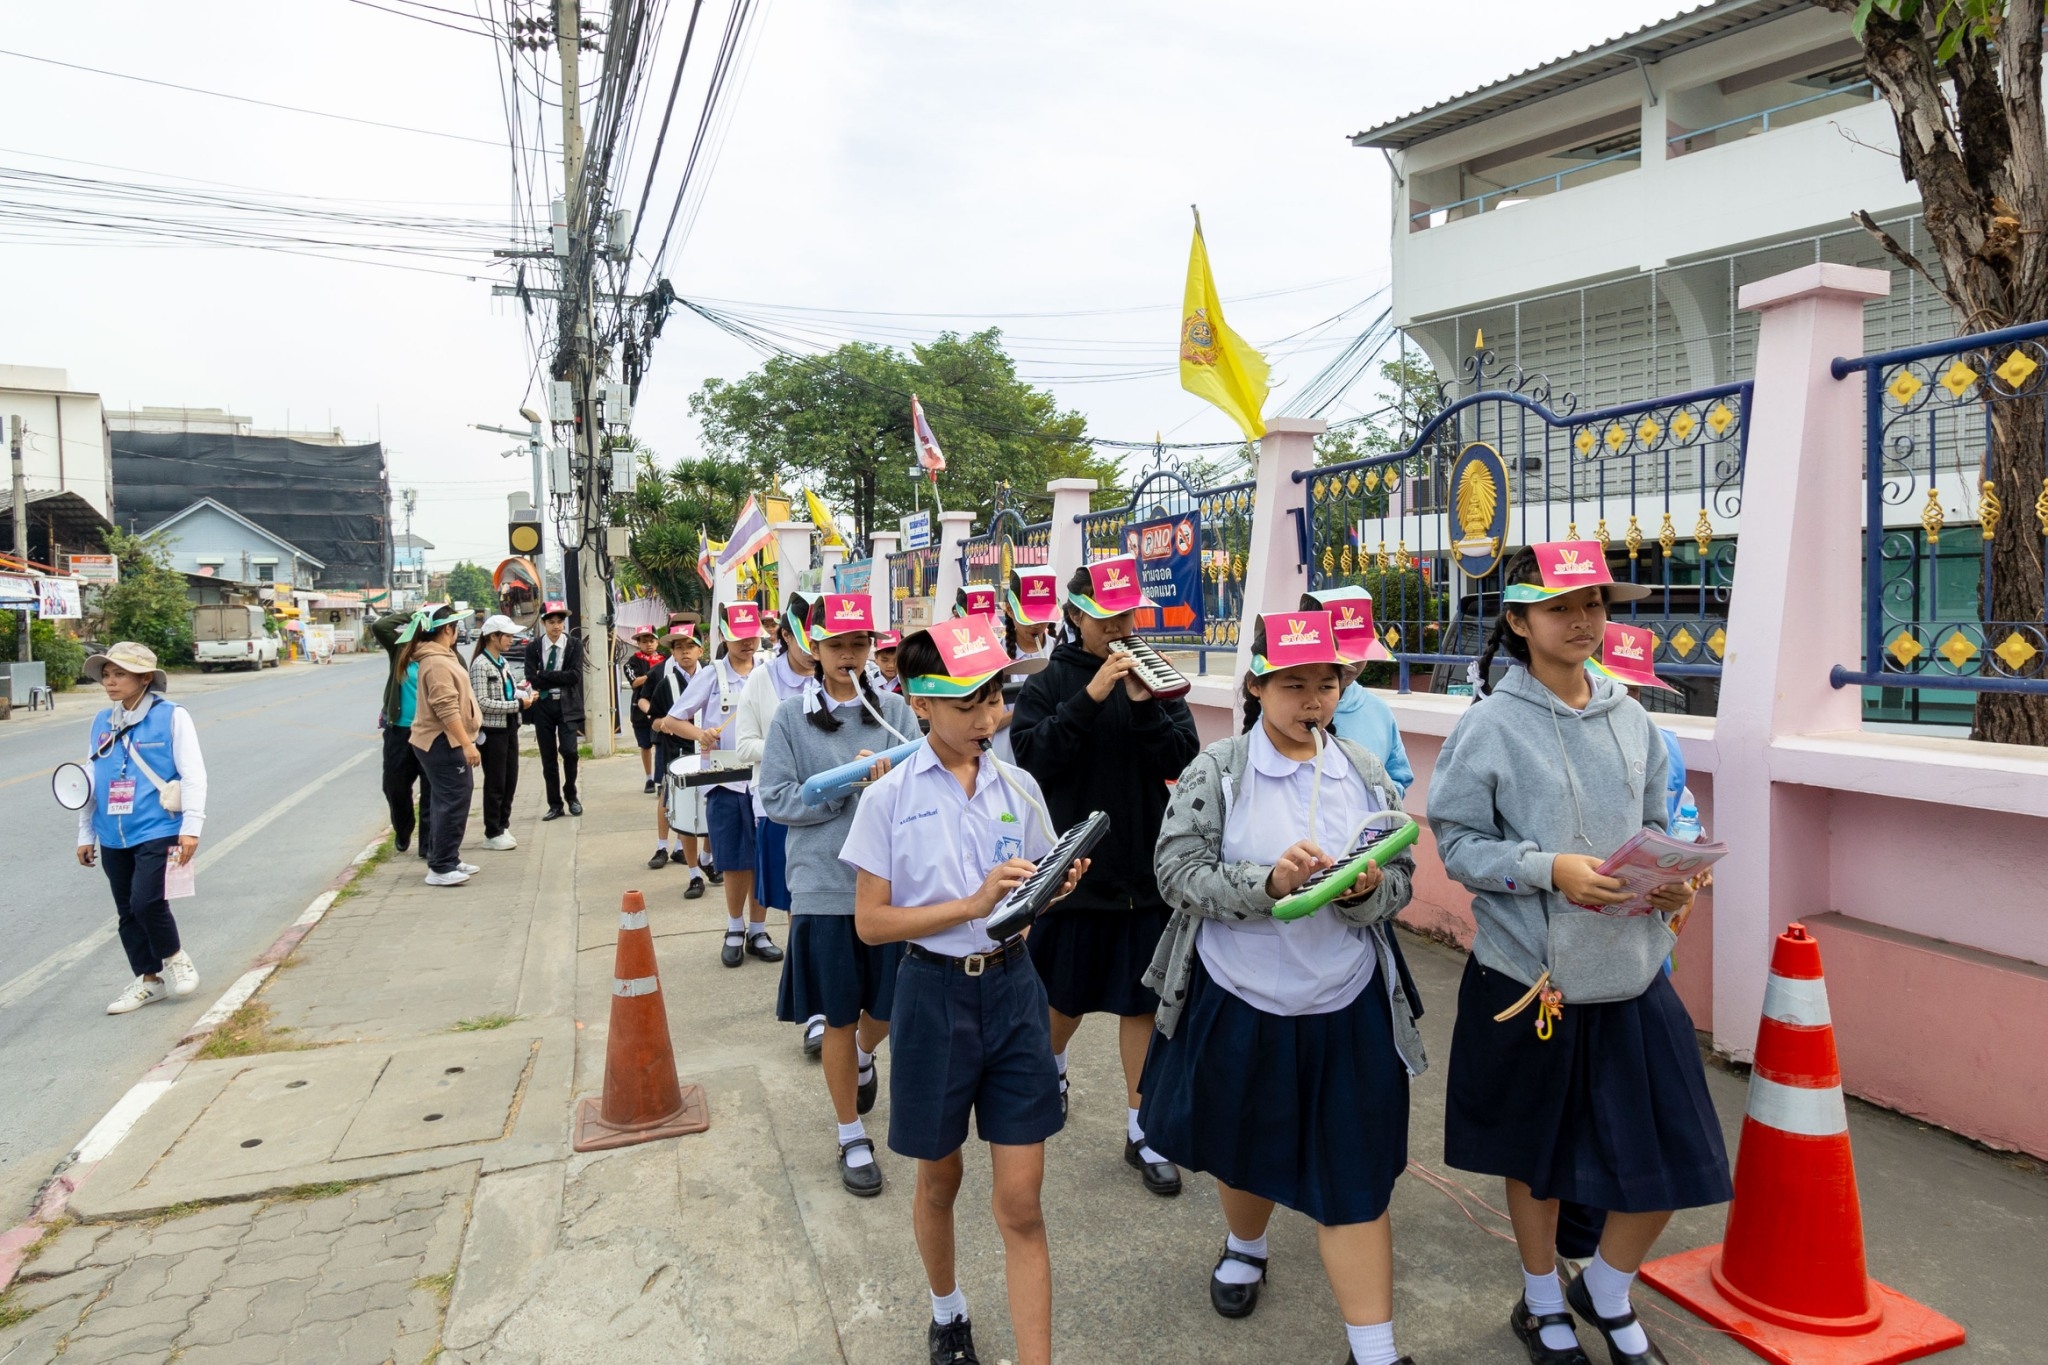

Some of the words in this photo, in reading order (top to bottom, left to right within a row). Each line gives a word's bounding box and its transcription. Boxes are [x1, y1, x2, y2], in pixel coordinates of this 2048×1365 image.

[1154, 528, 1170, 547] NO
[1559, 549, 1578, 564] V
[1106, 568, 1120, 580] V
[1142, 563, 1172, 582] ห้ามจอด
[1034, 580, 1043, 590] V
[842, 599, 855, 611] V
[1341, 607, 1354, 620] V
[1288, 619, 1306, 634] V
[1335, 619, 1359, 627] STAR
[952, 628, 970, 644] V
[1281, 633, 1314, 643] STAR
